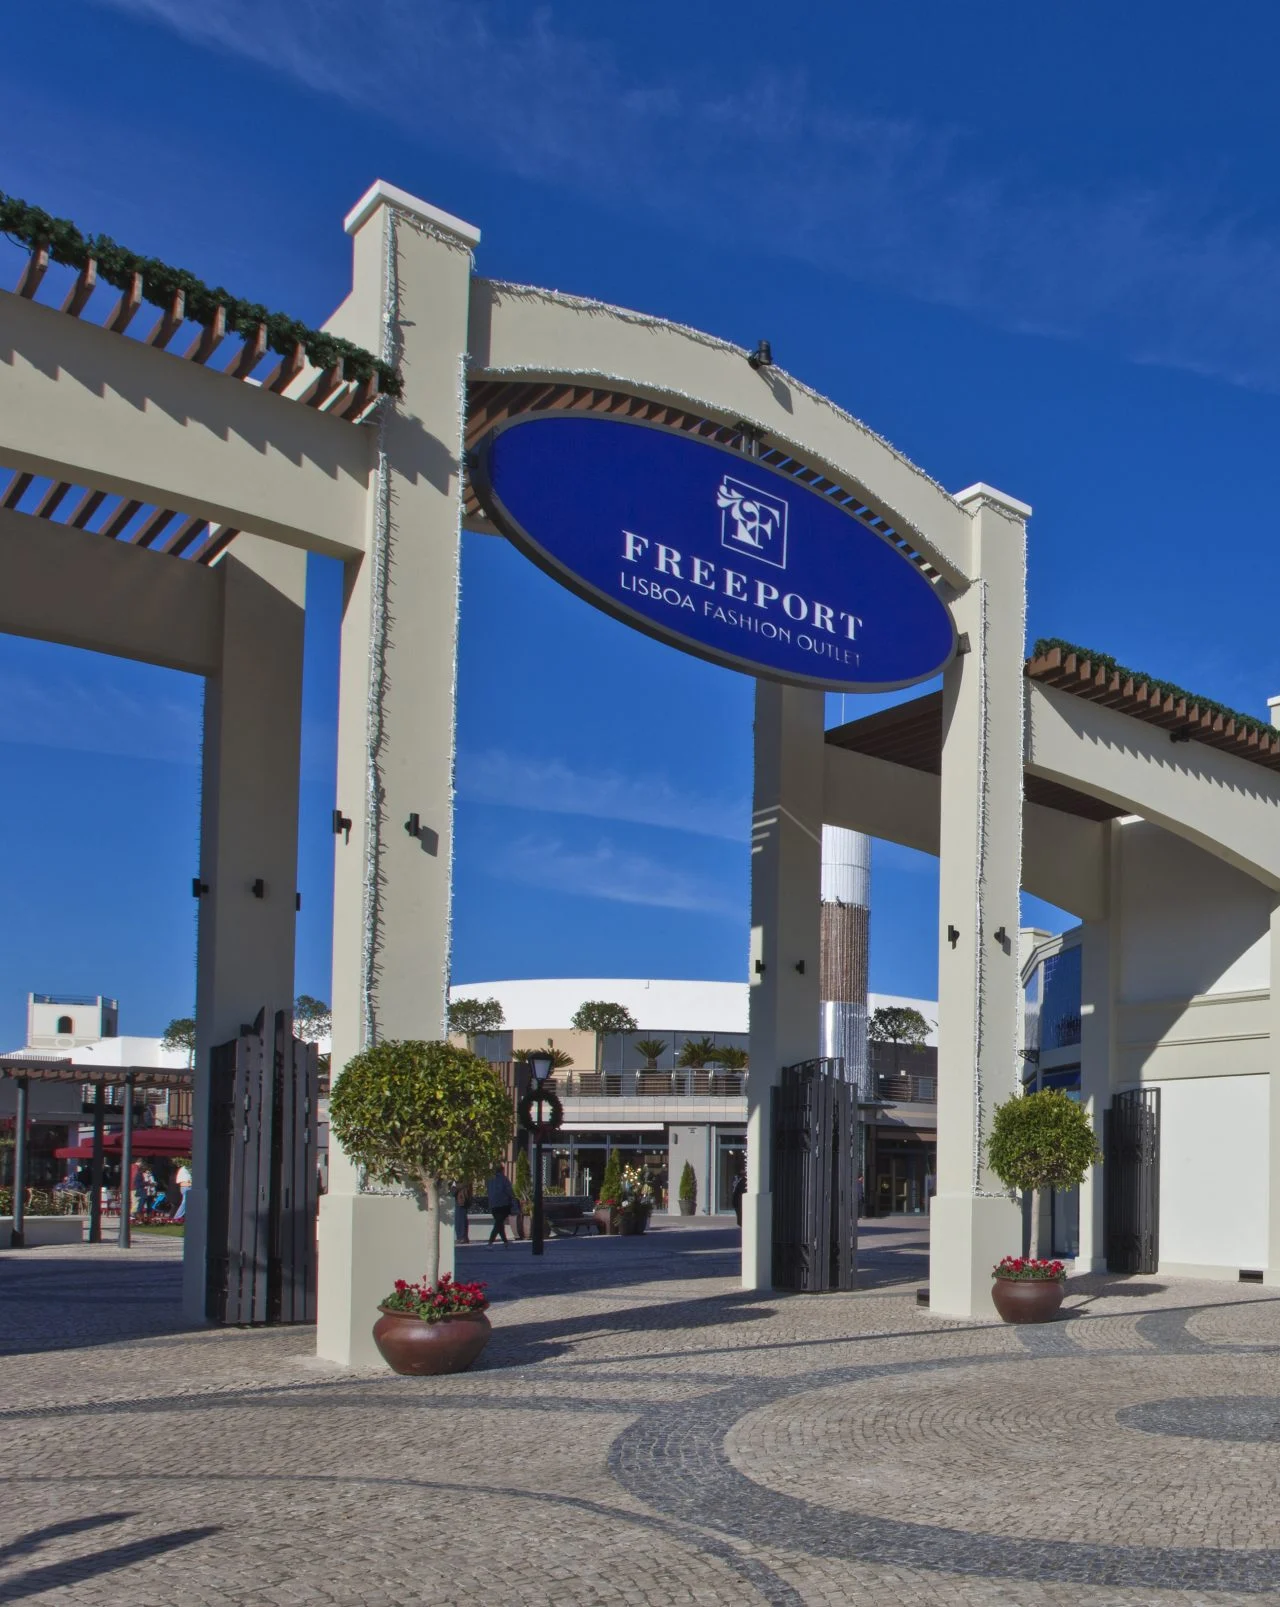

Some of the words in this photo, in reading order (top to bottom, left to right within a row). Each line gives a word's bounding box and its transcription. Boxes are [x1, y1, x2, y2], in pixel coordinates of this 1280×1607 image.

[620, 571, 696, 613] LISBOA
[703, 600, 791, 645] FASHION
[796, 634, 862, 668] OUTLET
[621, 529, 863, 641] FREEPORT
